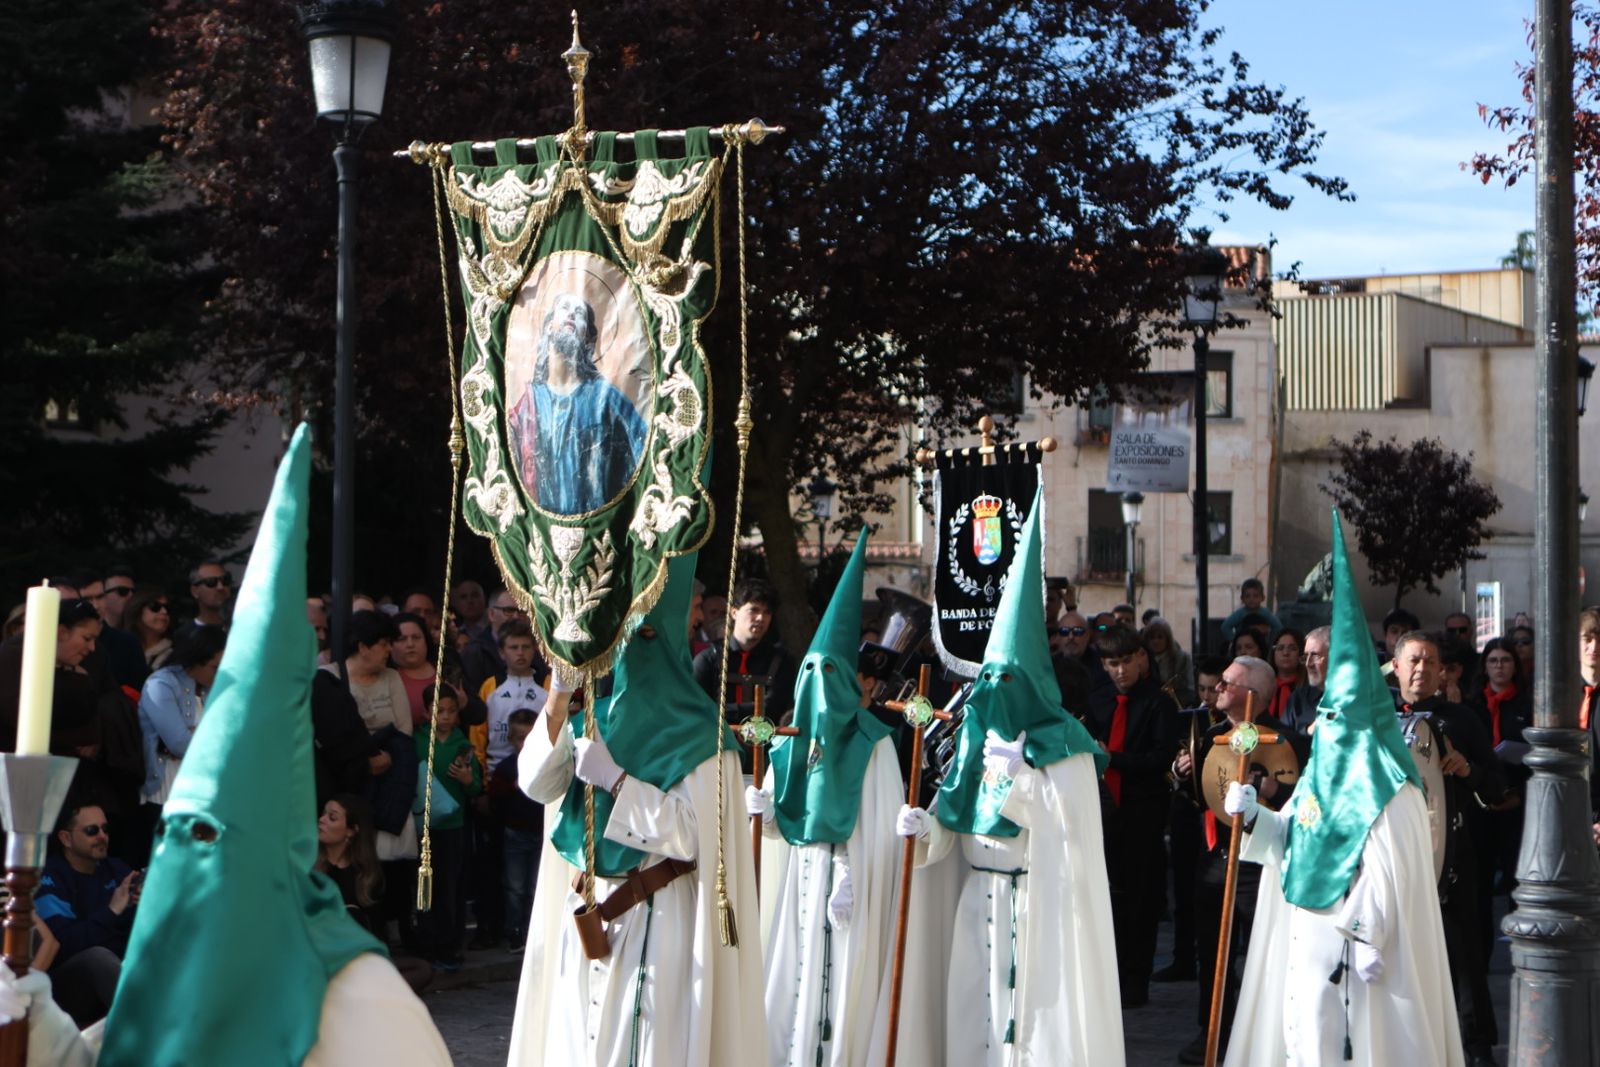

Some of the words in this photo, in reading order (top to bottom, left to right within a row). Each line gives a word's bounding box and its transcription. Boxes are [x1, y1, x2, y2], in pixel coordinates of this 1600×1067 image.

[1116, 433, 1141, 444] SALA
[1143, 433, 1156, 444] DE
[1115, 445, 1184, 457] EXPOSICIONES
[1114, 457, 1137, 465] SANTO
[1137, 457, 1171, 465] DOMINGO
[941, 608, 977, 619] BANDA
[979, 607, 996, 618] DE
[960, 620, 976, 631] DE
